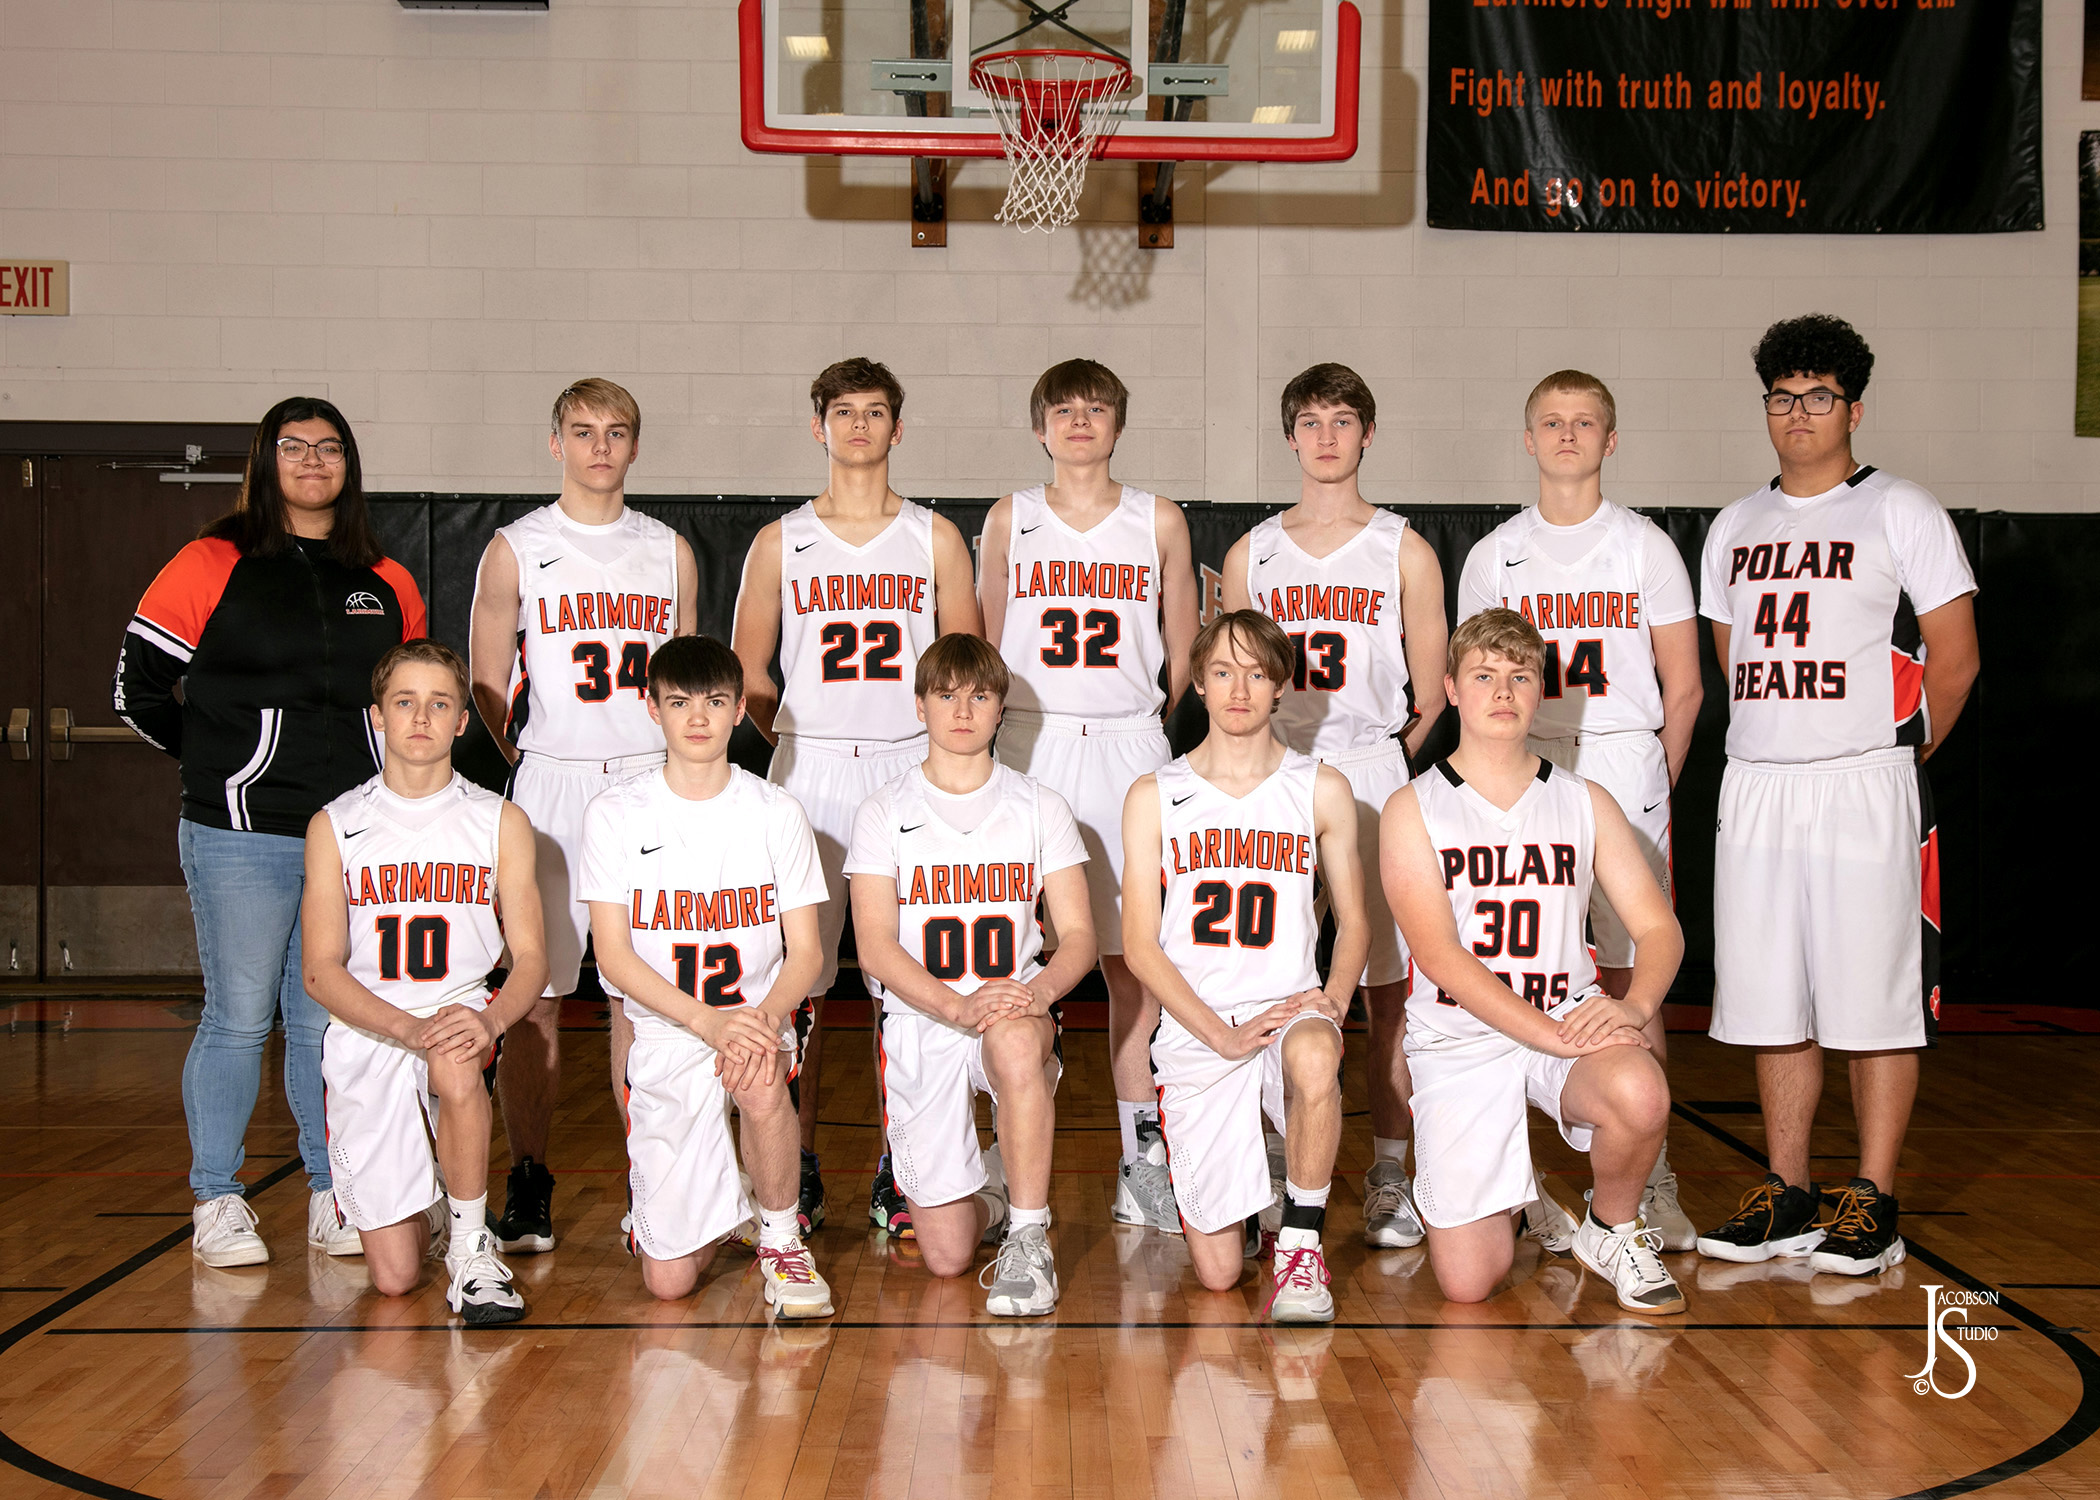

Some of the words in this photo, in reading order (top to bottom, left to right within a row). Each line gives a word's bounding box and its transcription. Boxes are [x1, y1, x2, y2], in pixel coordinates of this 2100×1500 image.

[1451, 68, 1525, 117] Fight
[1540, 70, 1603, 108] with
[1618, 72, 1692, 110] truth
[1708, 72, 1762, 110] and
[1778, 72, 1887, 120] loyalty.
[1471, 168, 1530, 206] And
[1545, 178, 1583, 216] go
[1600, 178, 1637, 208] on
[1652, 172, 1681, 208] to
[1696, 172, 1807, 218] victory.
[0, 266, 54, 308] EXIT
[1016, 561, 1151, 602] LARIMORE
[1730, 542, 1855, 586] POLAR
[539, 593, 672, 635] LARIMORE
[792, 574, 927, 615] LARIMORE
[1502, 591, 1639, 630] ARIMORE
[1754, 592, 1811, 649] 44
[820, 621, 903, 684] 22
[1040, 608, 1121, 669] 32
[1288, 630, 1348, 693] 13
[573, 641, 648, 704] 34
[1544, 638, 1610, 700] 14
[1735, 660, 1846, 702] BEARS
[1171, 828, 1310, 875] LARIMORE
[1439, 843, 1576, 890] POLAR
[344, 861, 492, 907] LARIMORE
[1191, 880, 1278, 950] 20
[1473, 899, 1541, 960] 30
[375, 914, 451, 983] 10
[922, 914, 1016, 983] 00
[672, 942, 747, 1009] 12
